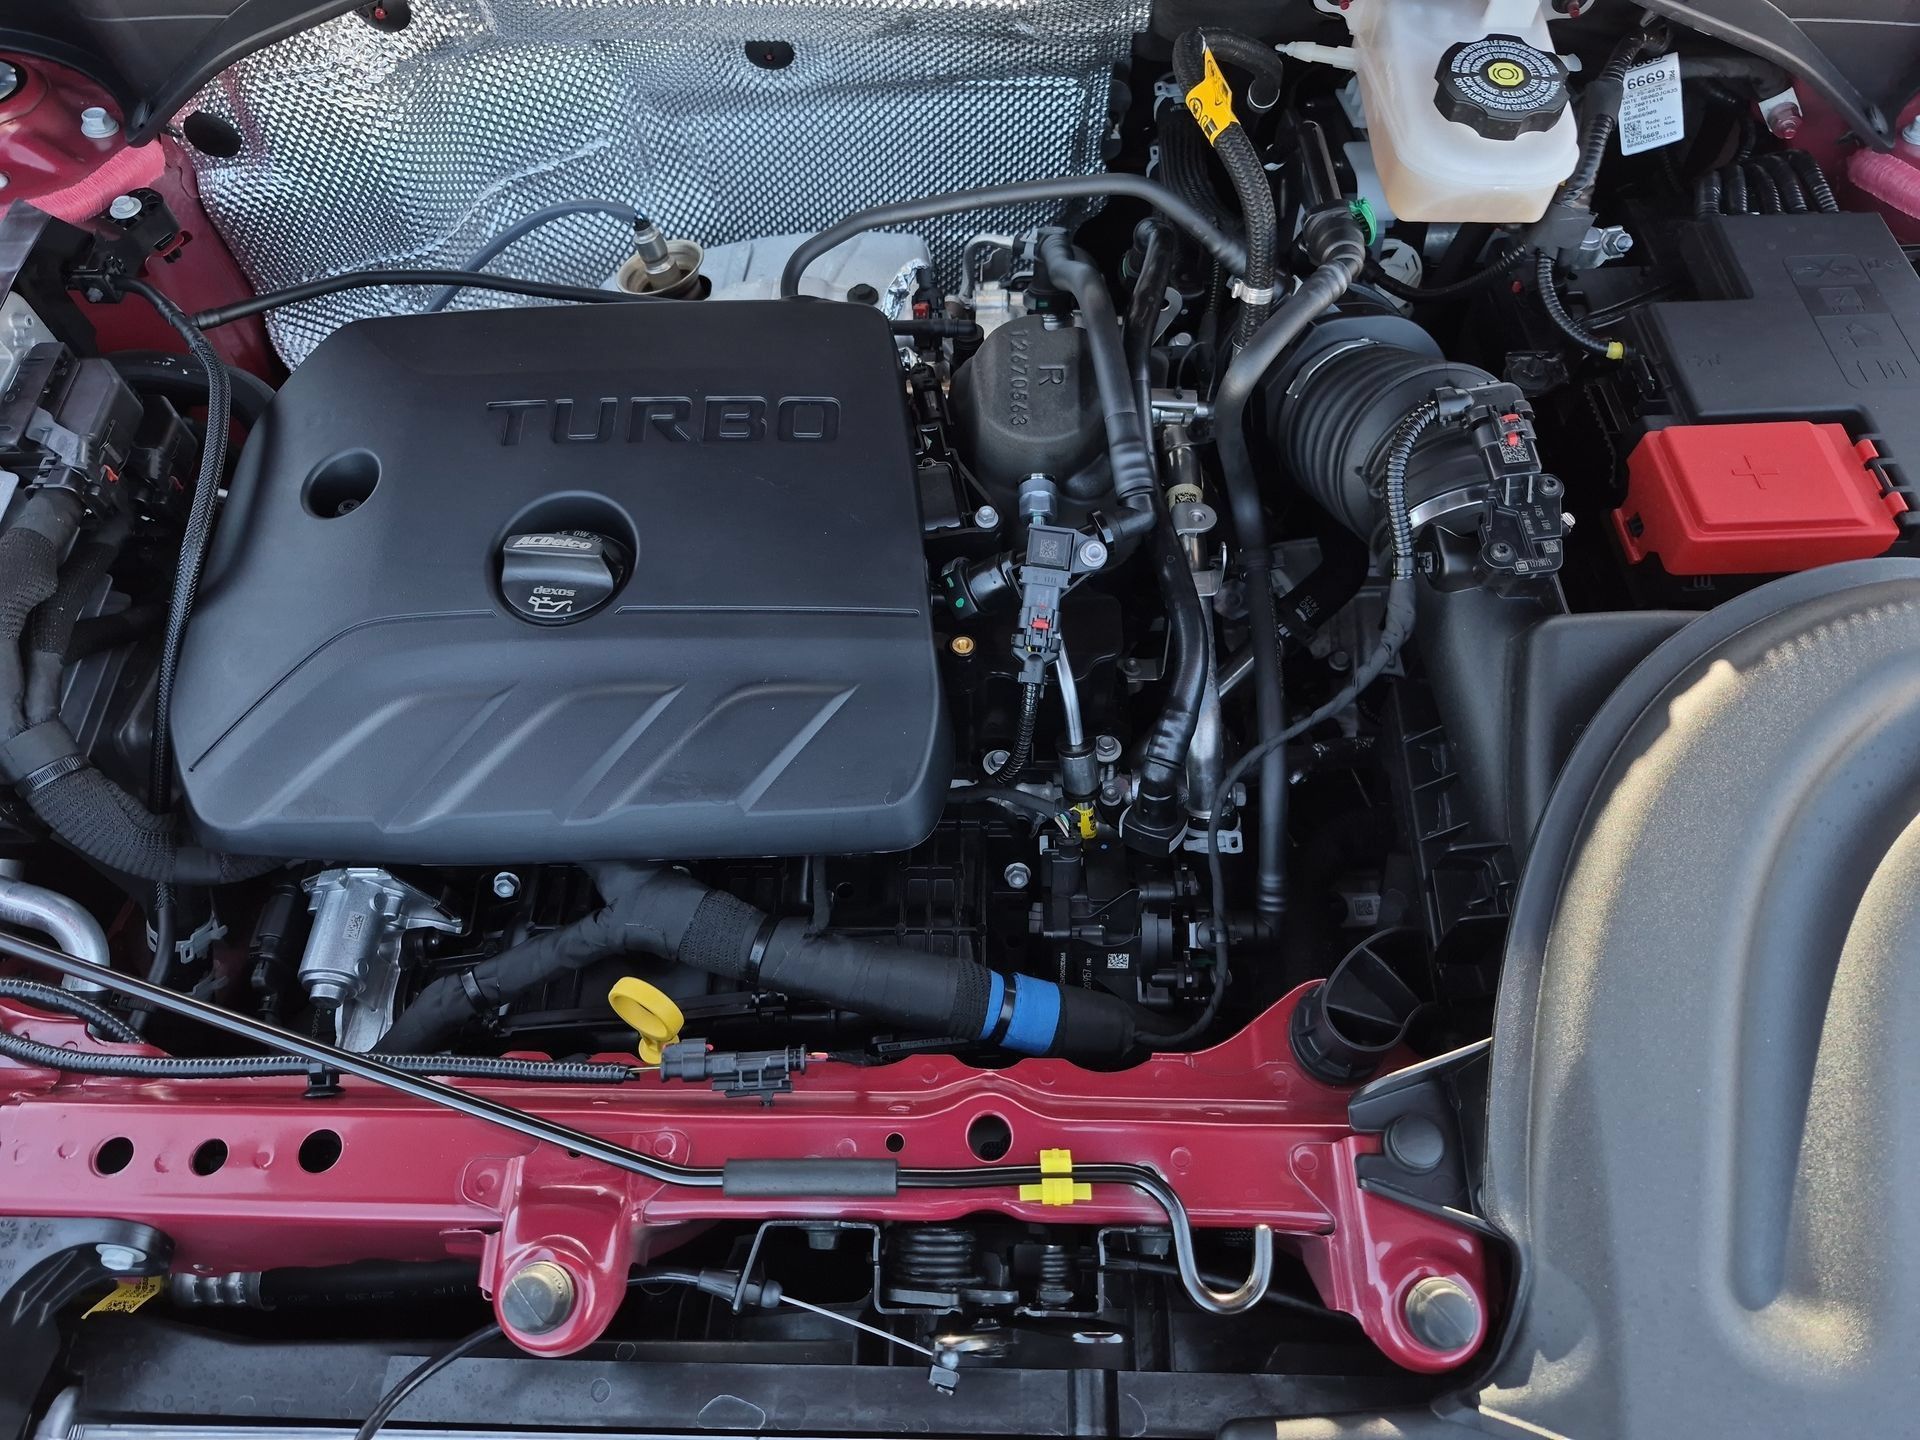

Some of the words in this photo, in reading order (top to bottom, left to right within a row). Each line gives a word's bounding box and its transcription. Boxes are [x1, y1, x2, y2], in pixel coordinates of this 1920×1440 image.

[1627, 70, 1665, 90] 6669
[1010, 329, 1029, 425] 12670563
[1038, 363, 1066, 386] R
[486, 396, 841, 446] TURBO
[513, 536, 592, 549] ACDelco
[533, 586, 577, 597] dexos
